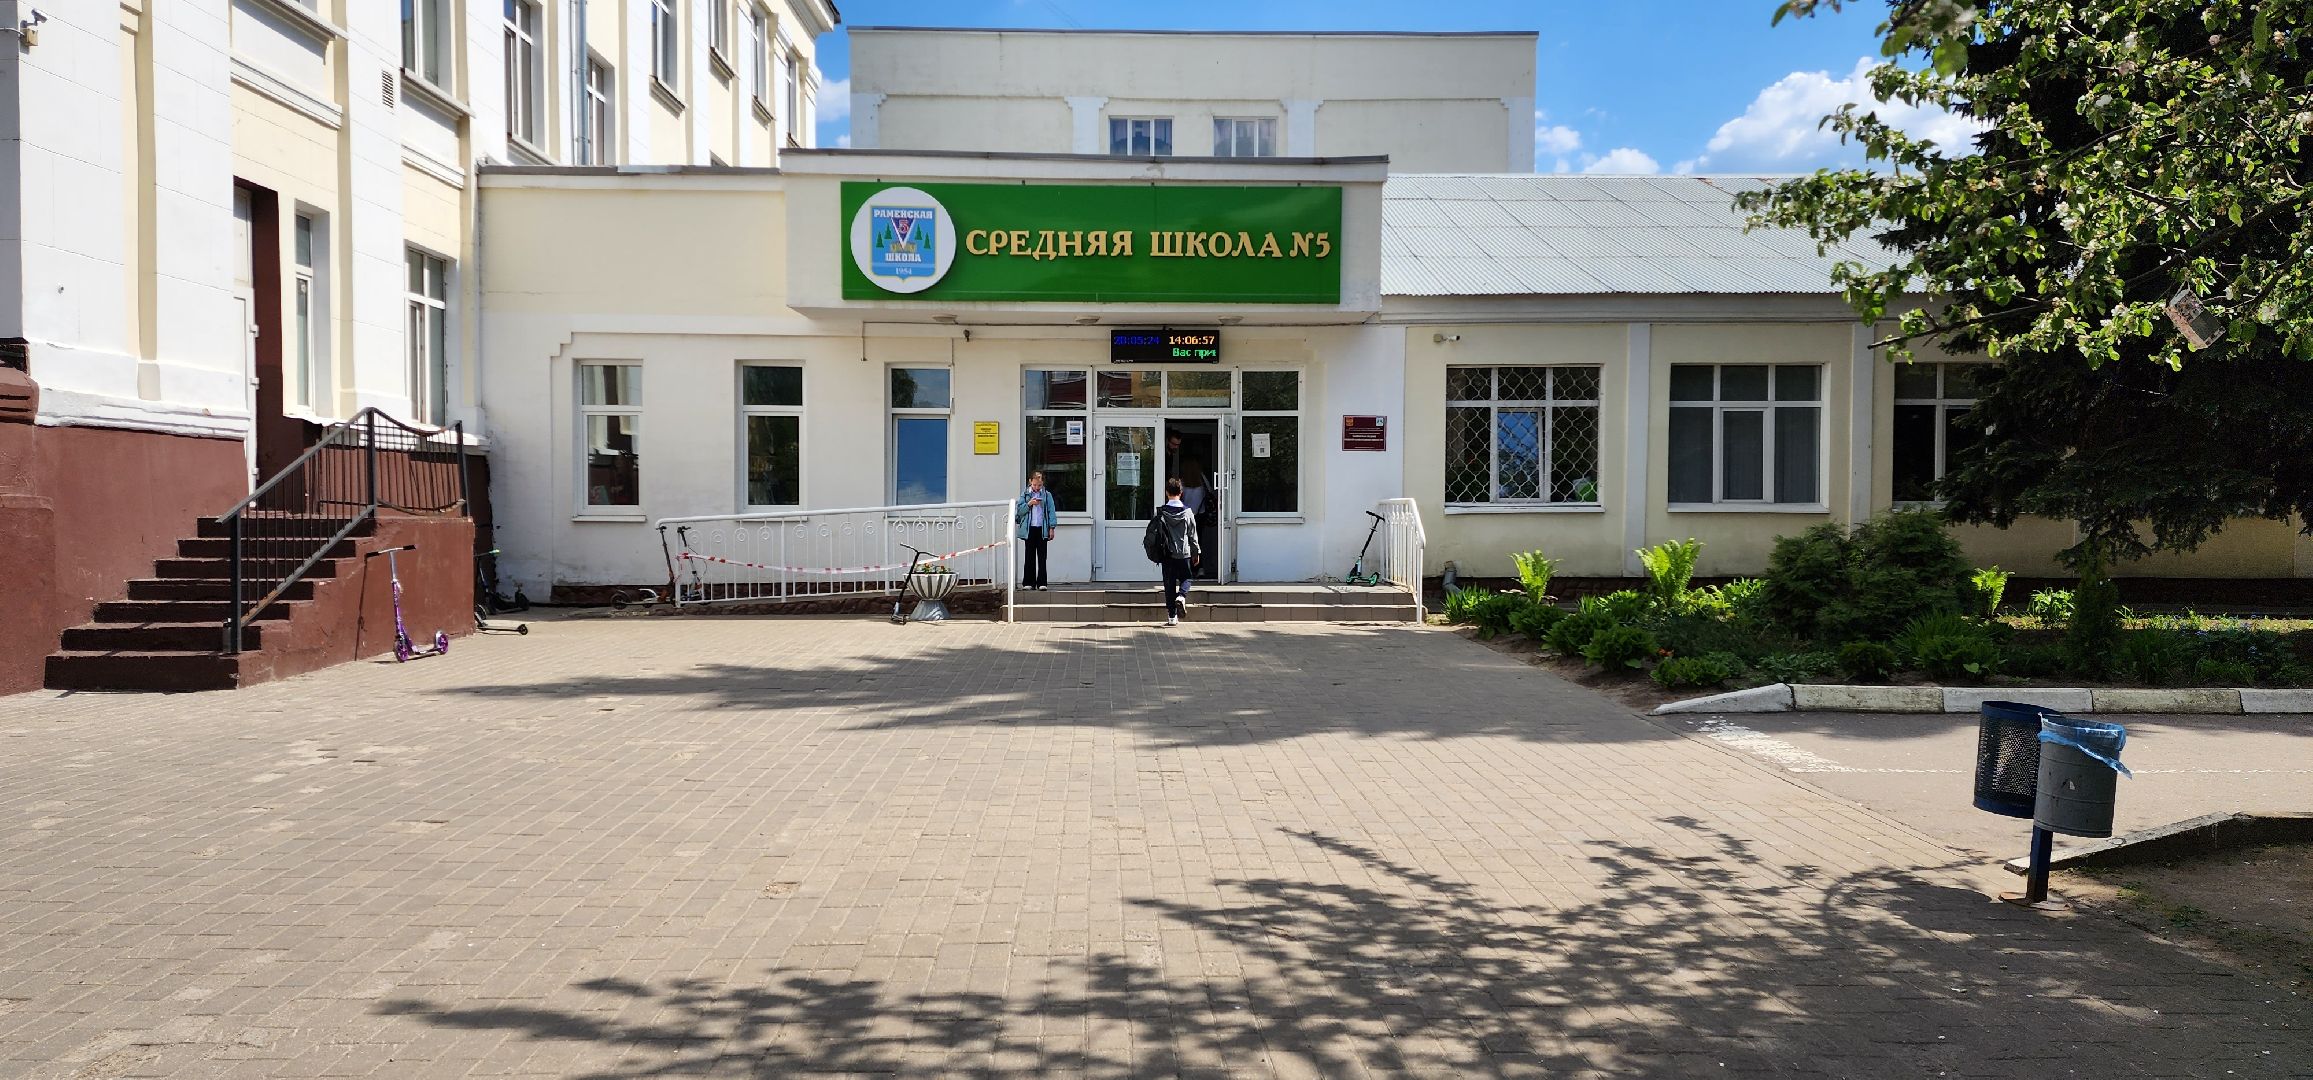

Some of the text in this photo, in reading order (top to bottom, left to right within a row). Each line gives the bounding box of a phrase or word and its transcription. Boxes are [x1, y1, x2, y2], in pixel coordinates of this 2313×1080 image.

[873, 208, 933, 220] РАМЕНСКАЯ
[898, 219, 910, 234] 5
[966, 229, 1133, 260] СРЕДНЯЯ
[1150, 231, 1283, 258] ШКОЛА
[885, 252, 922, 262] ШКОЛА
[1169, 335, 1215, 345] 14:06:57
[1172, 347, 1191, 356] Вас
